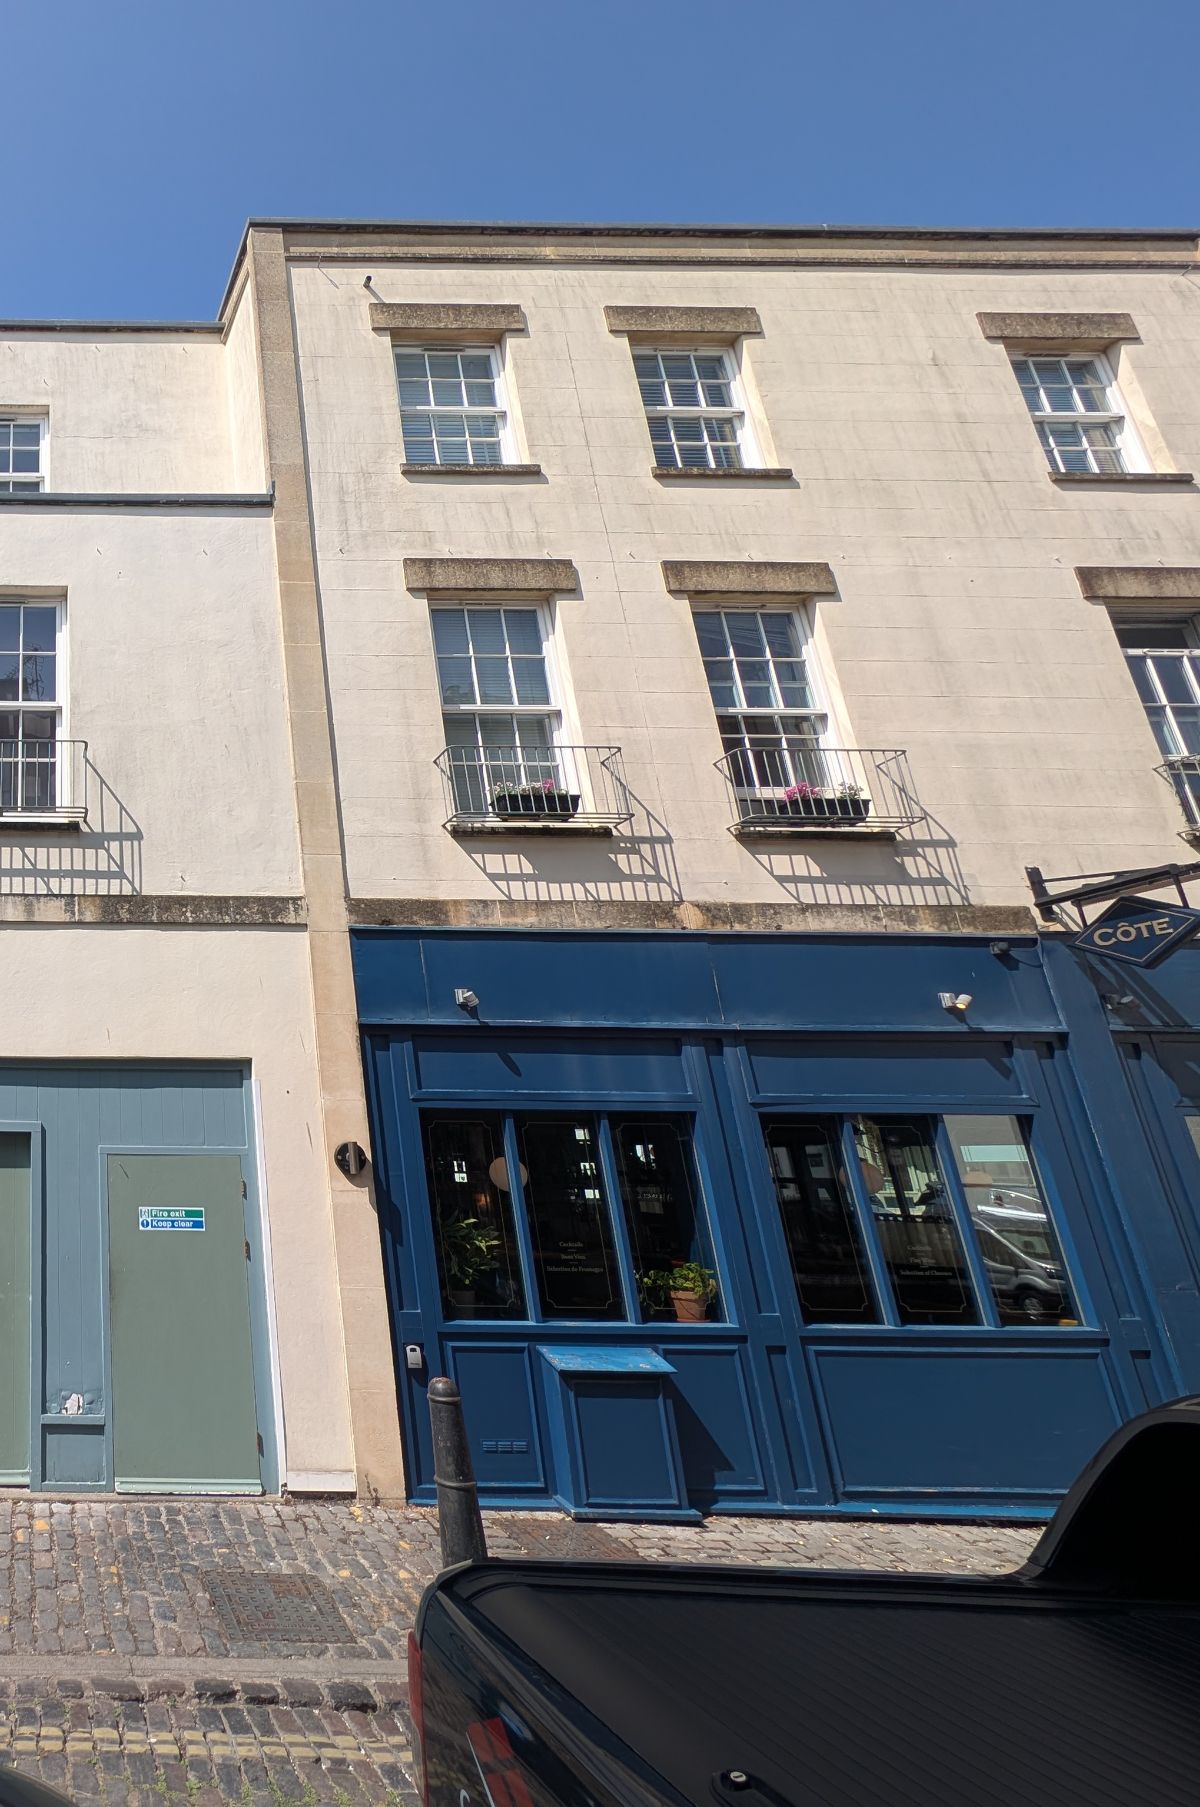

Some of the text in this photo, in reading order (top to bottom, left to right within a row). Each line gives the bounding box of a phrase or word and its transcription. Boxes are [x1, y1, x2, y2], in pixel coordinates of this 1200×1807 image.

[1093, 917, 1175, 946] CÔTE
[151, 1209, 168, 1217] Fire
[152, 1219, 172, 1228] Keep
